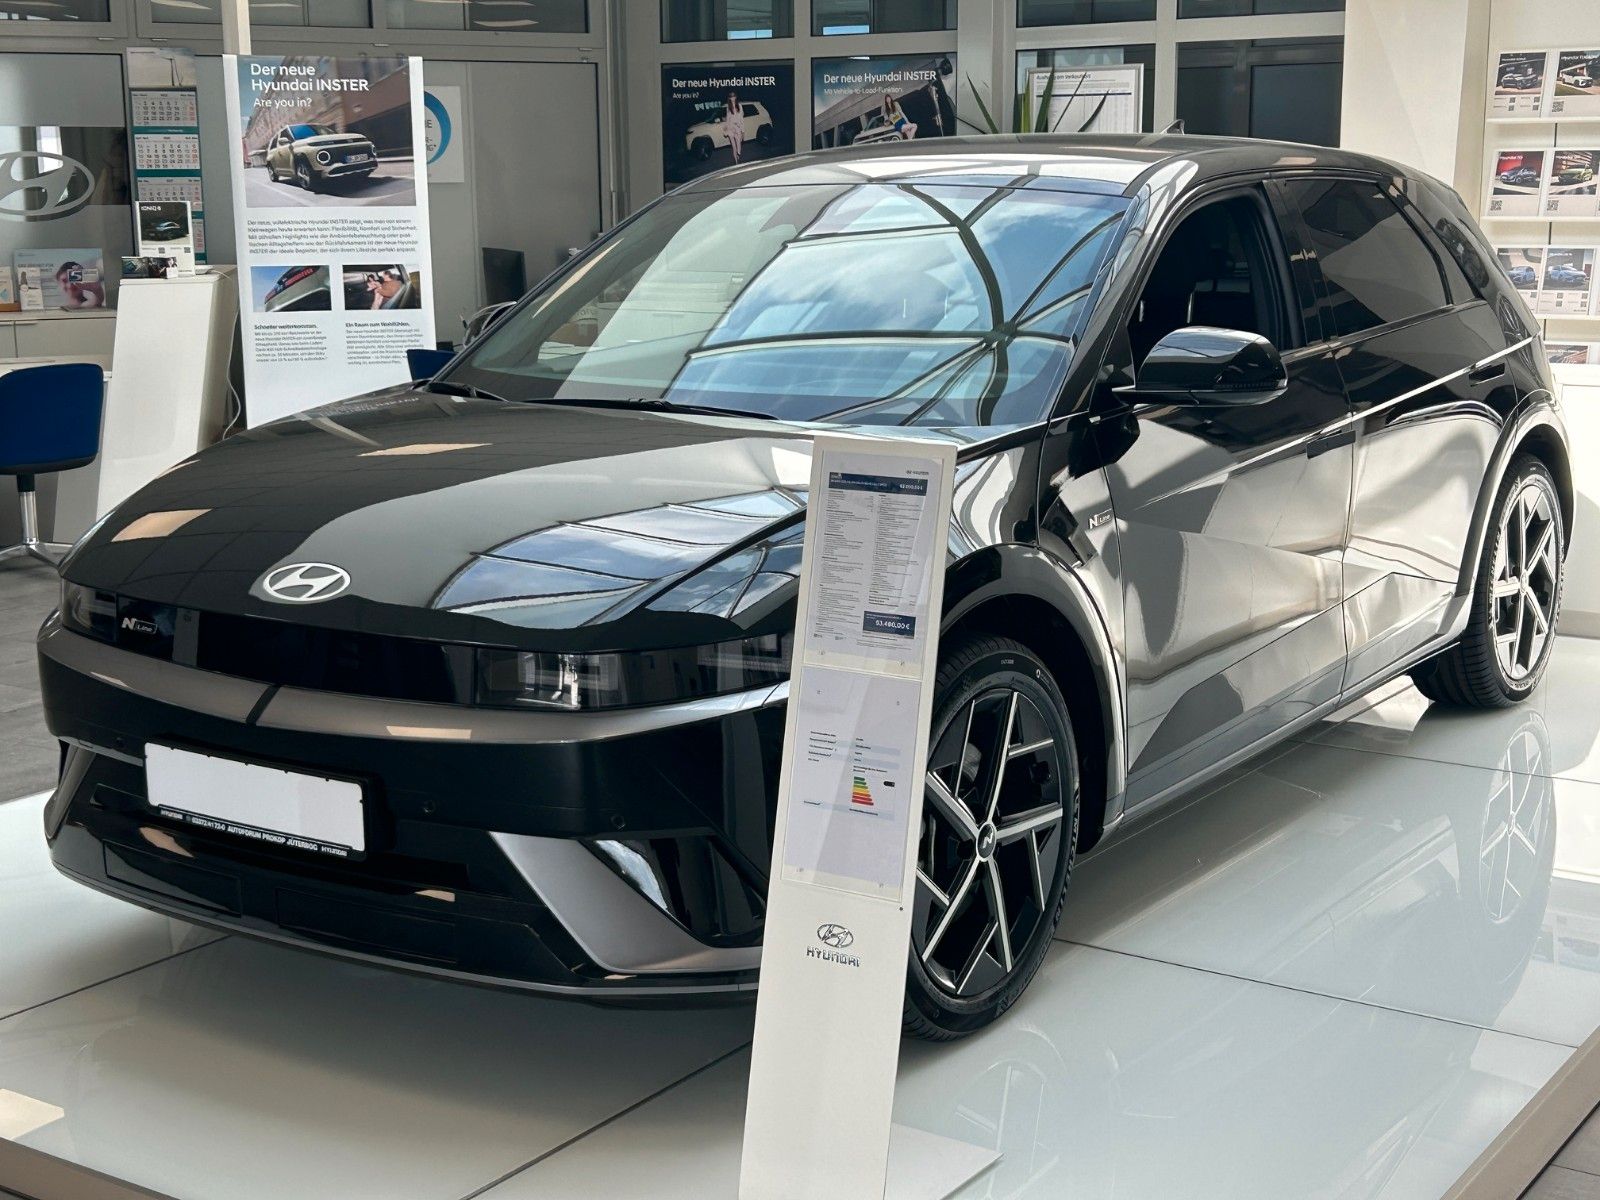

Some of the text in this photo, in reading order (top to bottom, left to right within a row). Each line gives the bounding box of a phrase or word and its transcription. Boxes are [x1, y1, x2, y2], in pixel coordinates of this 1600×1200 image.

[250, 63, 316, 76] Der neue
[672, 78, 686, 88] Der
[709, 78, 744, 88] Hyundai
[744, 76, 776, 86] INSTER
[824, 74, 838, 84] Der
[864, 71, 902, 84] Hyundai
[904, 70, 936, 80] INSTER
[252, 78, 370, 94] Hyundai INSTER
[254, 97, 312, 109] Are you in?
[1089, 514, 1098, 530] N
[122, 617, 136, 630] N
[806, 946, 860, 968] HYUNDAI
